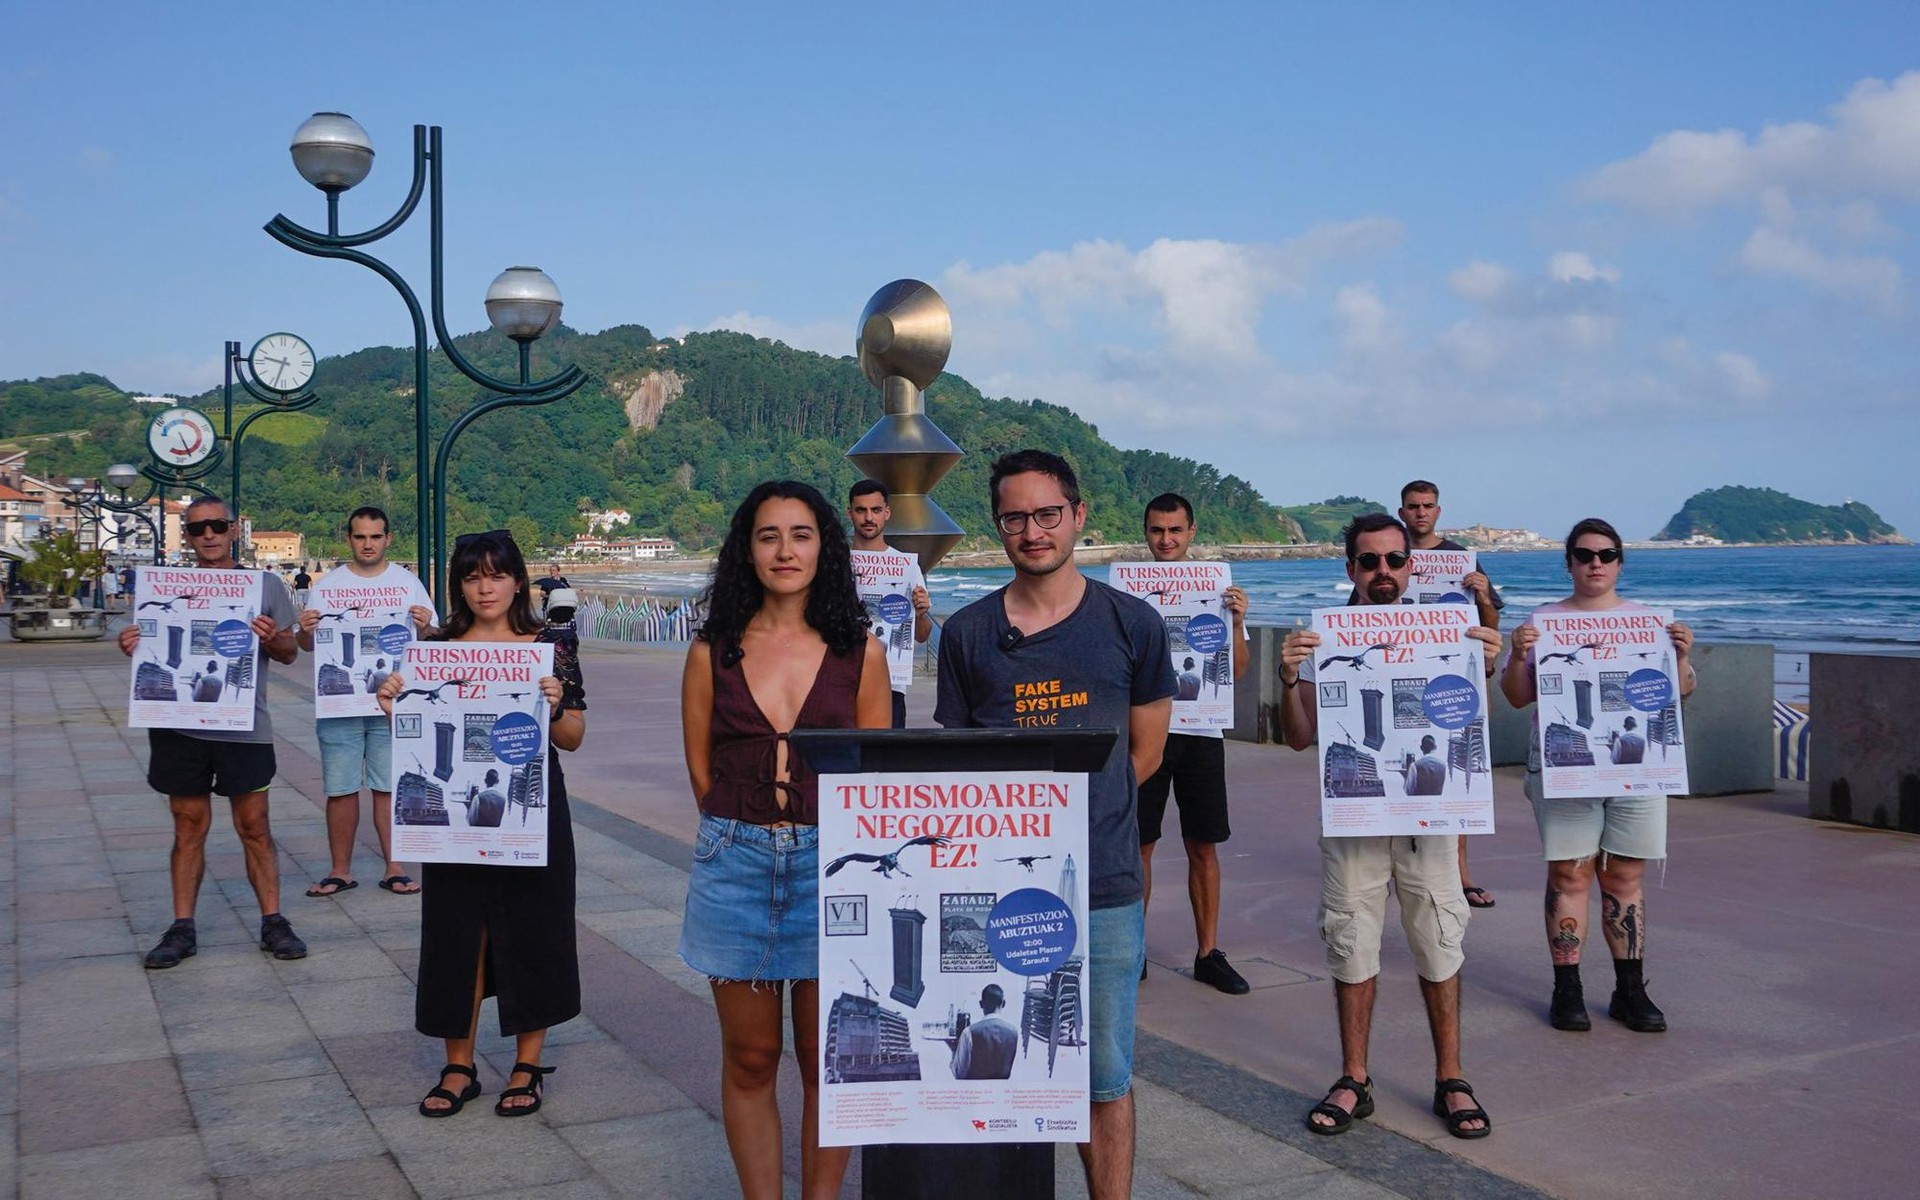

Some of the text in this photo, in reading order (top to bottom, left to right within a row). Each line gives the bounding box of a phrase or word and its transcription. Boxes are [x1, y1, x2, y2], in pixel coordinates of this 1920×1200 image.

[850, 554, 911, 566] ISMOAREN
[1412, 554, 1470, 564] SMOAREN
[856, 566, 904, 576] OZIOARI
[1117, 566, 1223, 579] TURISMOAREN
[1414, 565, 1464, 574] OZIOARI
[145, 571, 254, 585] TURISMOAREN
[859, 577, 876, 586] EZ!
[1416, 576, 1435, 584] EZ!
[153, 585, 245, 598] NEGOZIOARI
[320, 587, 408, 598] TURISMOAREN
[1126, 580, 1216, 592] NEGOZIOARI
[187, 599, 210, 609] EZ!
[327, 598, 402, 608] NEGOZIOARI
[1159, 594, 1182, 606] EZ!
[356, 609, 375, 618] EZ!
[1324, 610, 1468, 629] TURISMOAREN
[1543, 616, 1664, 631] TURISMOAREN
[1337, 628, 1459, 646] NEGOZIOARI
[1554, 632, 1655, 646] NEGOZIOARI
[407, 648, 542, 664] TURISMOAREN
[1384, 648, 1414, 664] EZ!
[1592, 647, 1618, 660] EZ!
[414, 666, 531, 681] NEGOZIOARI
[457, 685, 487, 699] EZ!
[1014, 680, 1060, 698] FAKE
[1323, 686, 1344, 698] VT
[1015, 692, 1088, 713] SYSTEM
[399, 717, 419, 730] VT
[1012, 712, 1059, 728] TRUE
[837, 784, 1069, 809] TURISMOAREN
[856, 813, 1050, 839] NEGOZIOARI
[930, 844, 978, 868] EZ!
[942, 896, 995, 906] ZARAUZ
[830, 902, 864, 922] VT
[990, 910, 1069, 928] MANIFESTAZIOA
[999, 922, 1064, 940] ABUZTUAK 2
[1024, 939, 1042, 947] 12:00
[1006, 946, 1062, 958] Udaletxe Plazan
[1022, 957, 1050, 966] Zarautz
